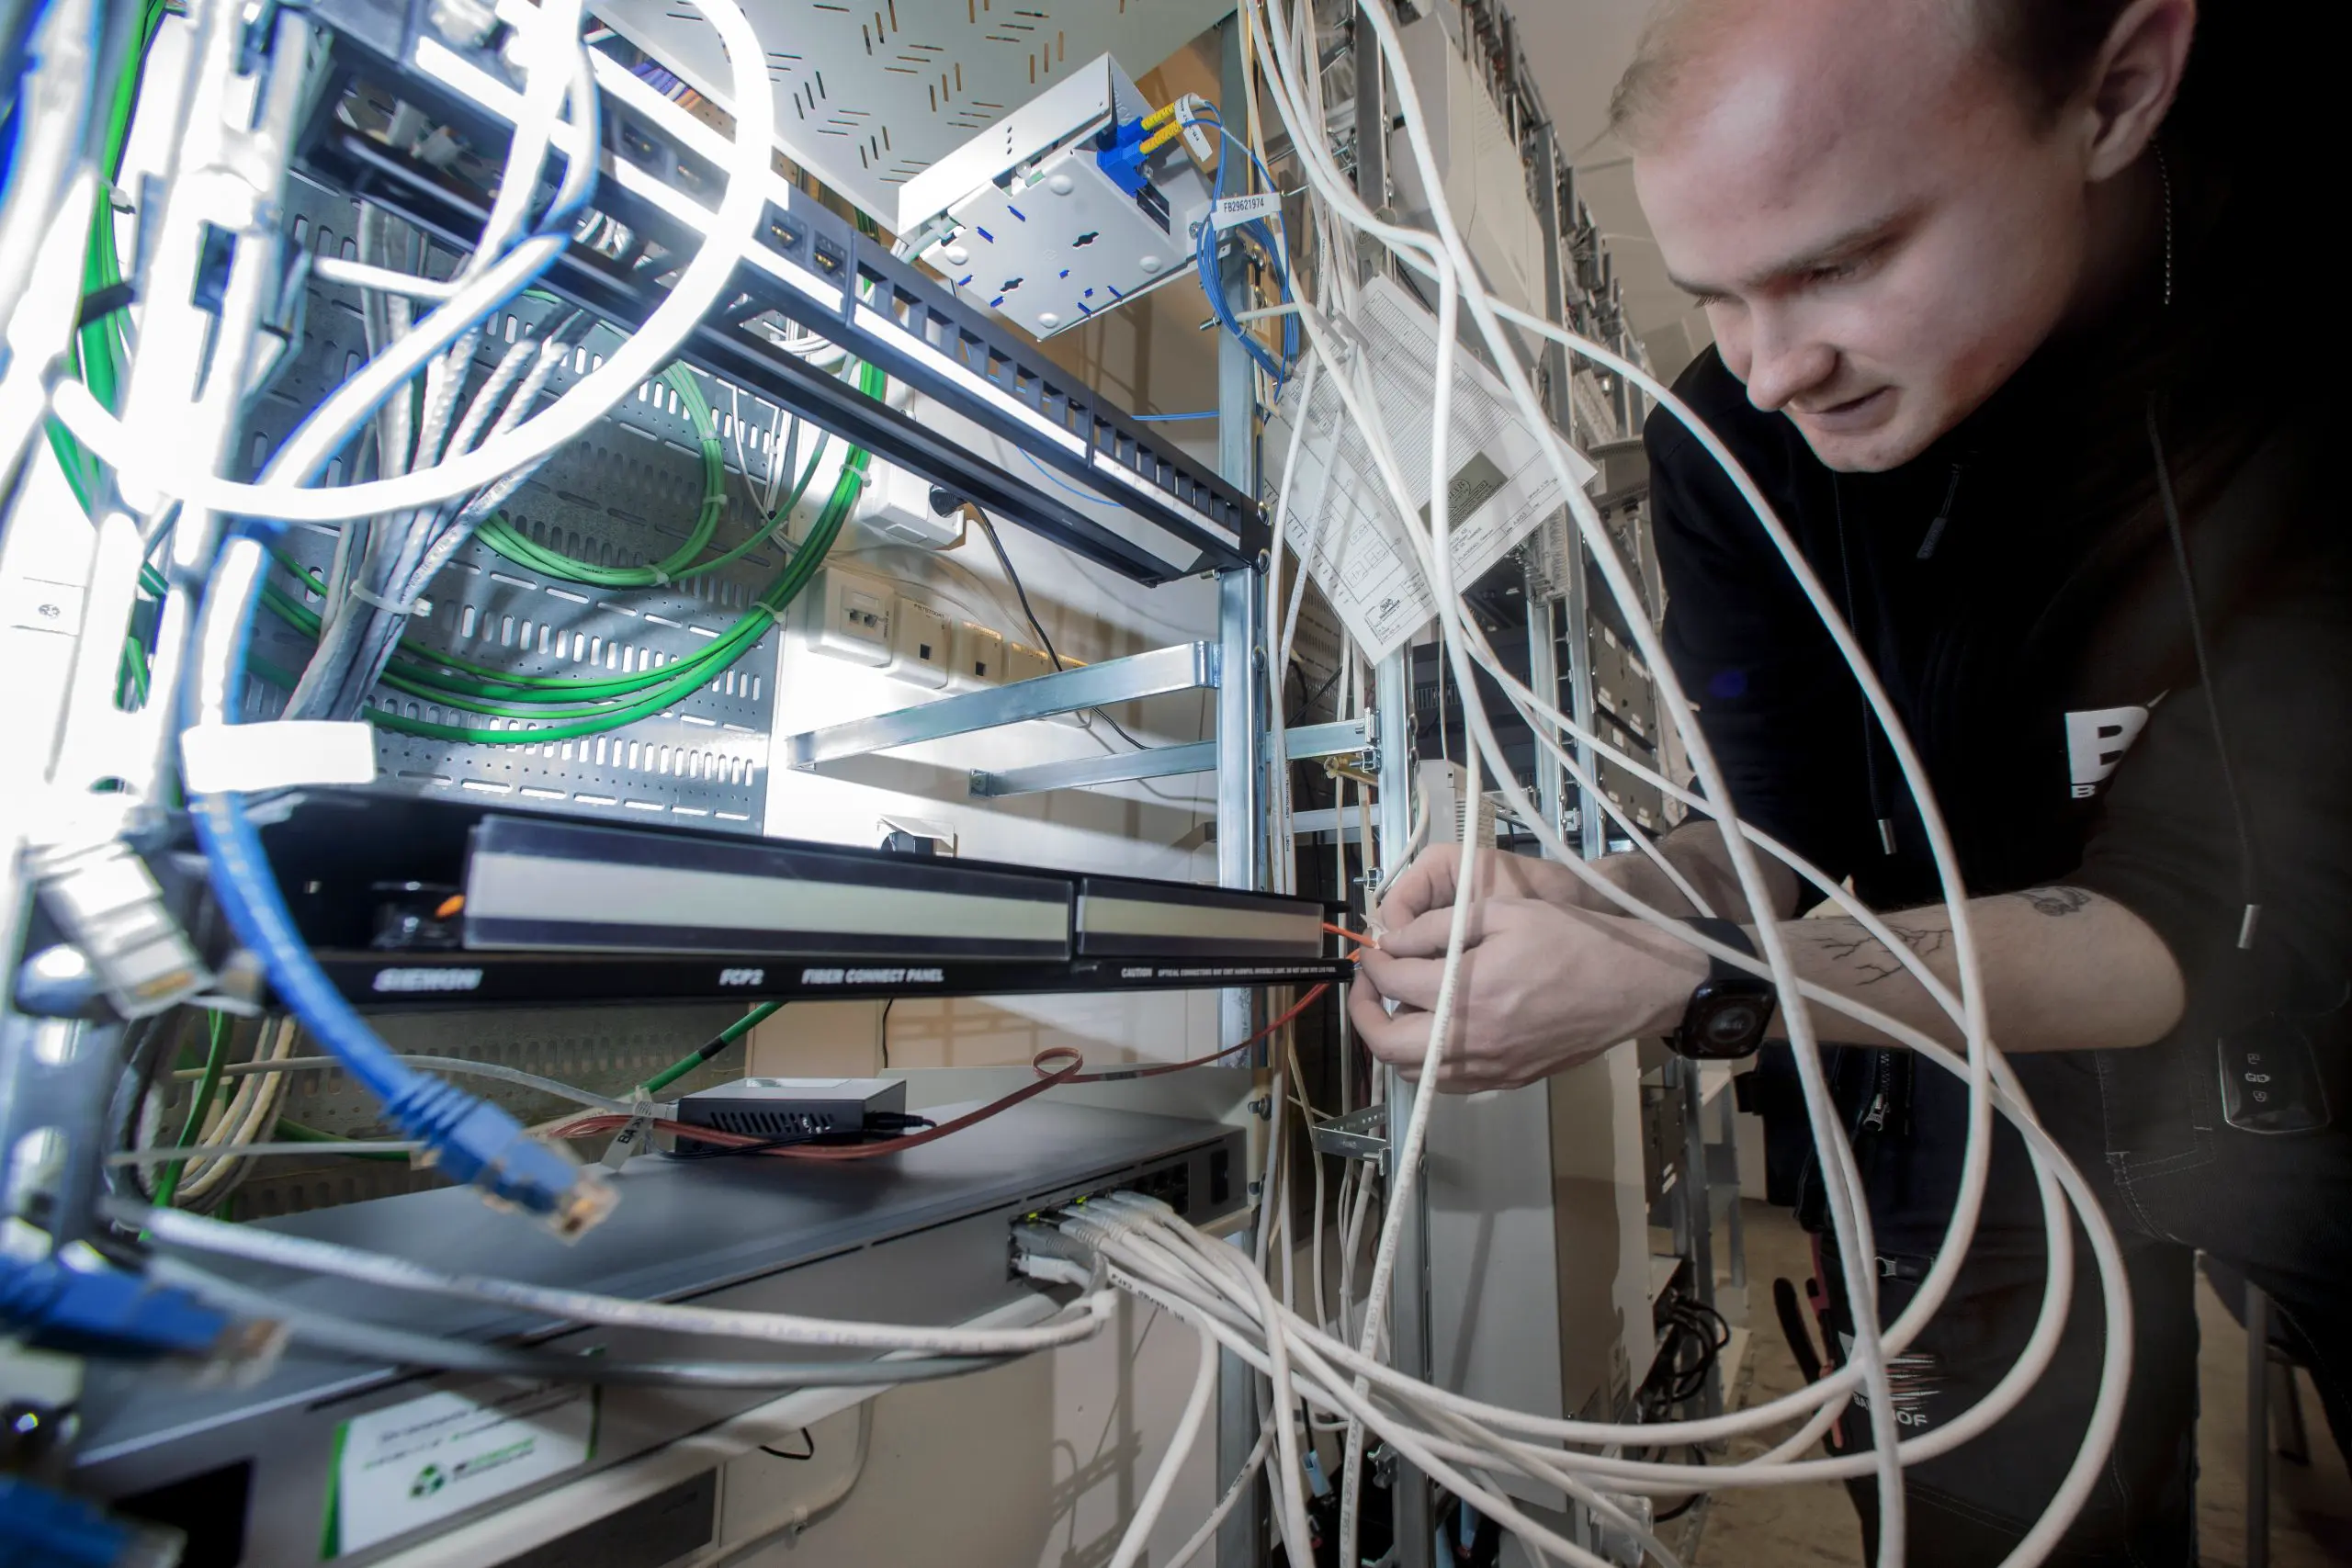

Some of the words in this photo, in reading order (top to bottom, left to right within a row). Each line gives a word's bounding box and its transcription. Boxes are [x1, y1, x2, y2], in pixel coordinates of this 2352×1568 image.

[1223, 197, 1264, 213] FB29621974
[718, 968, 764, 986] FCP2
[801, 968, 844, 985] FIBER
[845, 968, 906, 984] CONNECT
[906, 968, 944, 983] PANEL
[617, 1129, 639, 1145] BA
